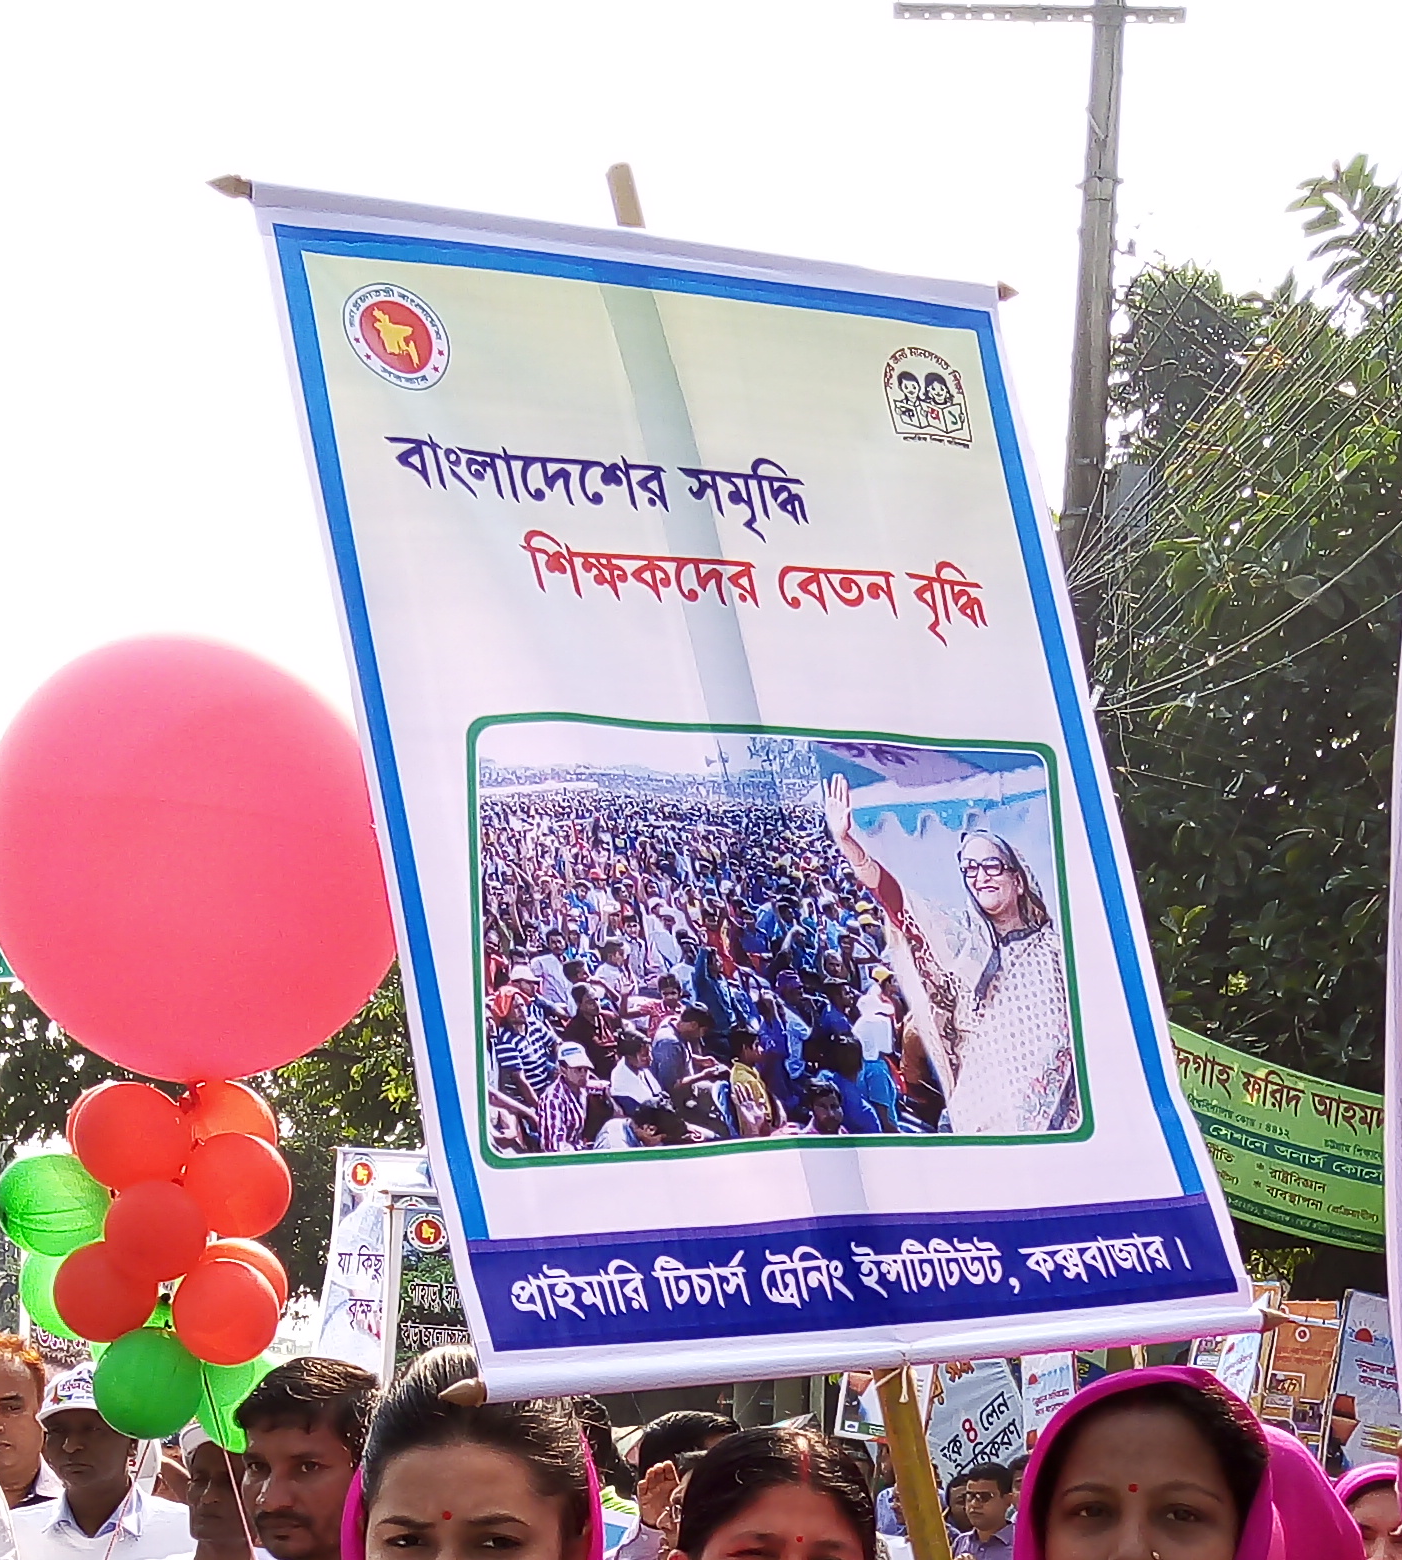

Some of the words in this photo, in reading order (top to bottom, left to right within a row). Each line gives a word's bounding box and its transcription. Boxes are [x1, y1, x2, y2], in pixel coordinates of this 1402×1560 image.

[385, 431, 668, 516] বাংলাদেশের
[679, 457, 811, 543] সমৃদ্ধি
[520, 529, 760, 609] শিক্ষকদের
[778, 564, 900, 619] বেতন
[906, 560, 989, 646] বৃদ্ধি
[1241, 1070, 1306, 1118] ফরিদ
[510, 1256, 647, 1323] প্রাইমারি
[652, 1249, 752, 1313] টিচার্স
[761, 1243, 856, 1310] ট্রেনিং
